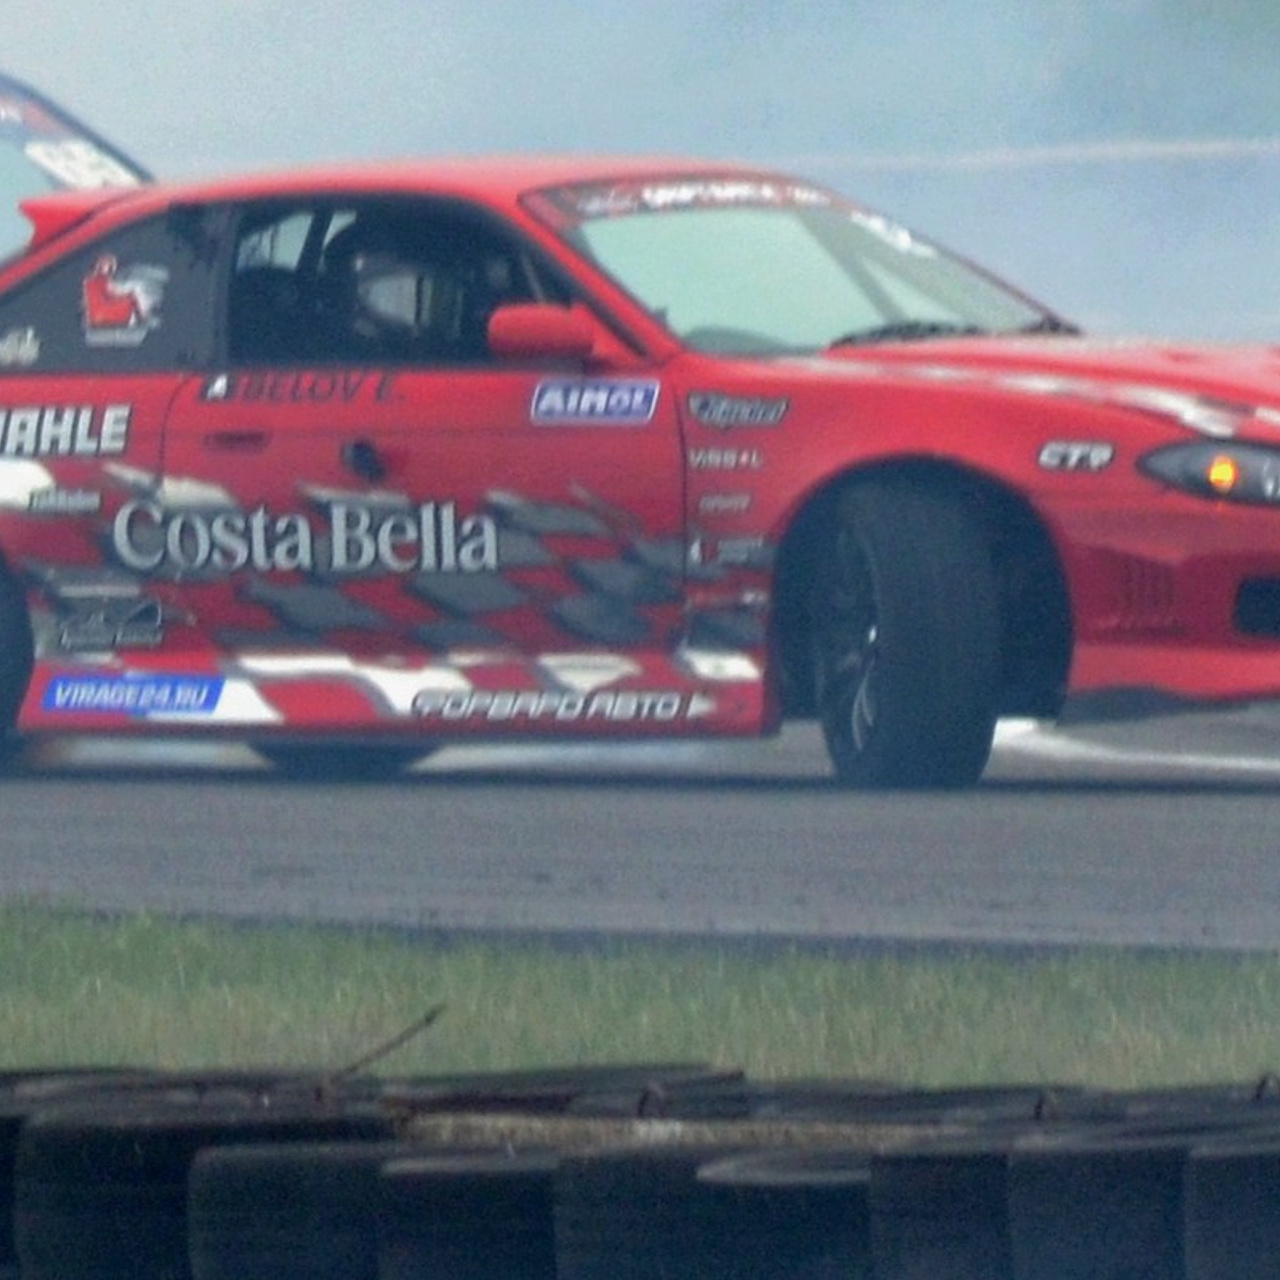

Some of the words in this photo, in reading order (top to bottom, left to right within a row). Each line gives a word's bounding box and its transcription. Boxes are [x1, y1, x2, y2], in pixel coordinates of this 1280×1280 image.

[538, 384, 651, 415] AIMOL
[0, 404, 132, 455] AHLE
[113, 498, 312, 570] Costa
[330, 500, 498, 572] Bella
